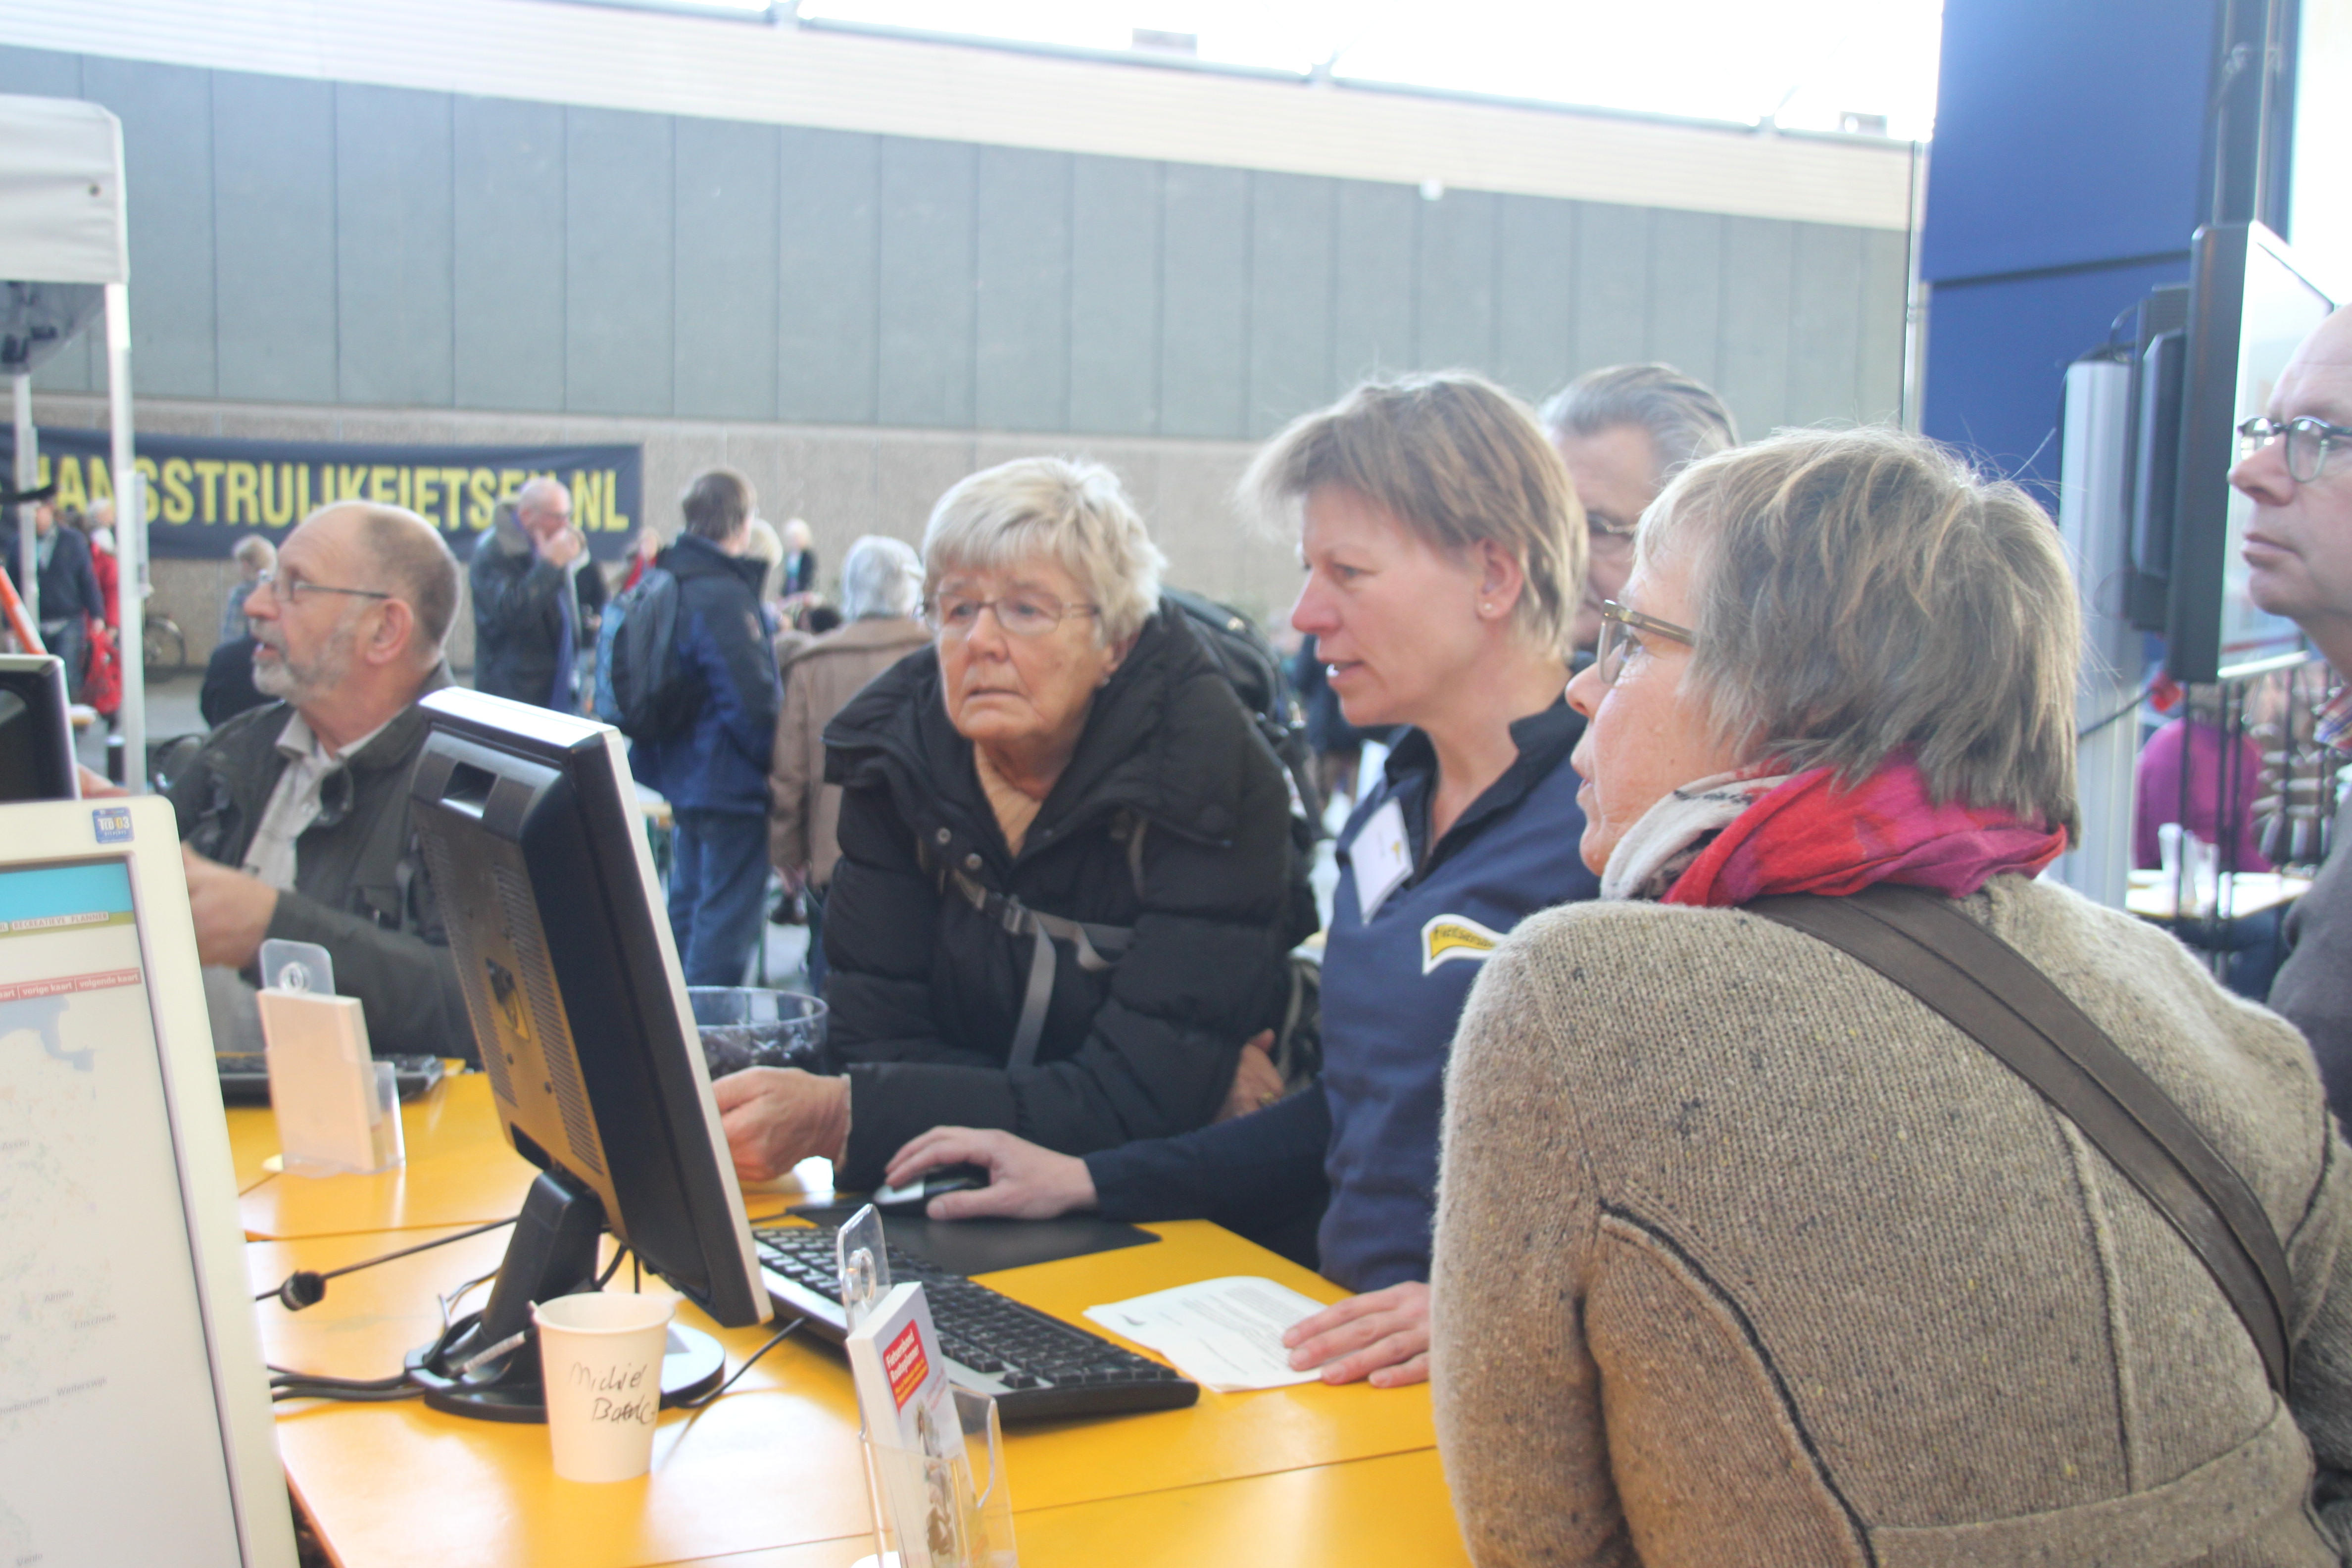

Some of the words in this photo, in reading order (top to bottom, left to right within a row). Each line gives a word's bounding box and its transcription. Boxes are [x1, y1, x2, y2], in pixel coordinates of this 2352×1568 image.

[14, 917, 66, 929] RECREATIEVE
[71, 912, 108, 923] PLANNER
[23, 985, 49, 995] vorige
[51, 982, 73, 991] kaart
[80, 976, 116, 988] volgende
[117, 973, 139, 983] kaart
[1, 1138, 30, 1151] Assen
[45, 1289, 74, 1303] Almelo
